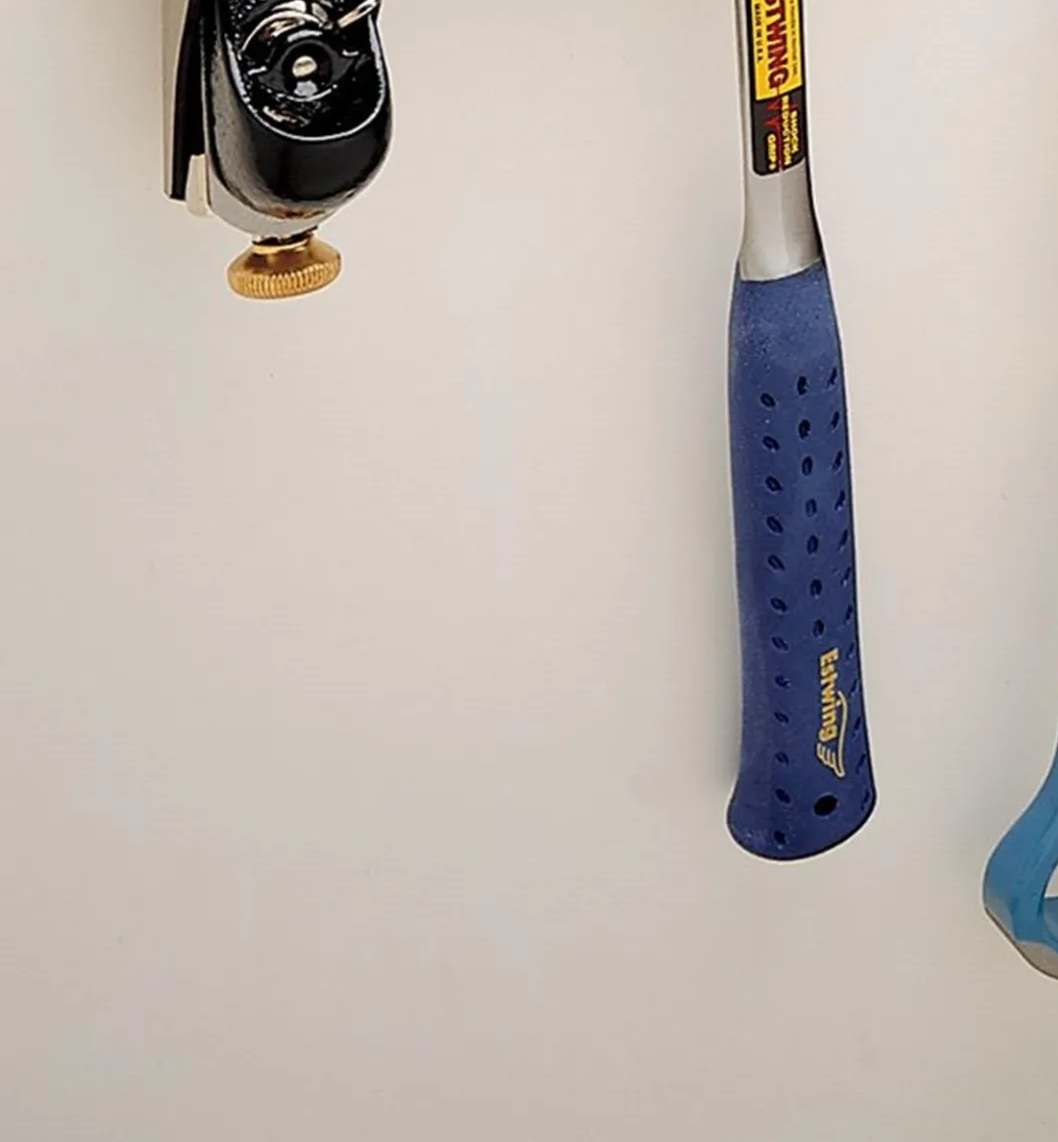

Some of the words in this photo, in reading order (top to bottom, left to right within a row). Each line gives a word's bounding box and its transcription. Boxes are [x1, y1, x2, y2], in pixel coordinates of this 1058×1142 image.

[754, 2, 762, 27] MADE
[781, 95, 792, 166] REDUCTION
[790, 110, 799, 154] SHOCK
[818, 647, 842, 743] Estwing
